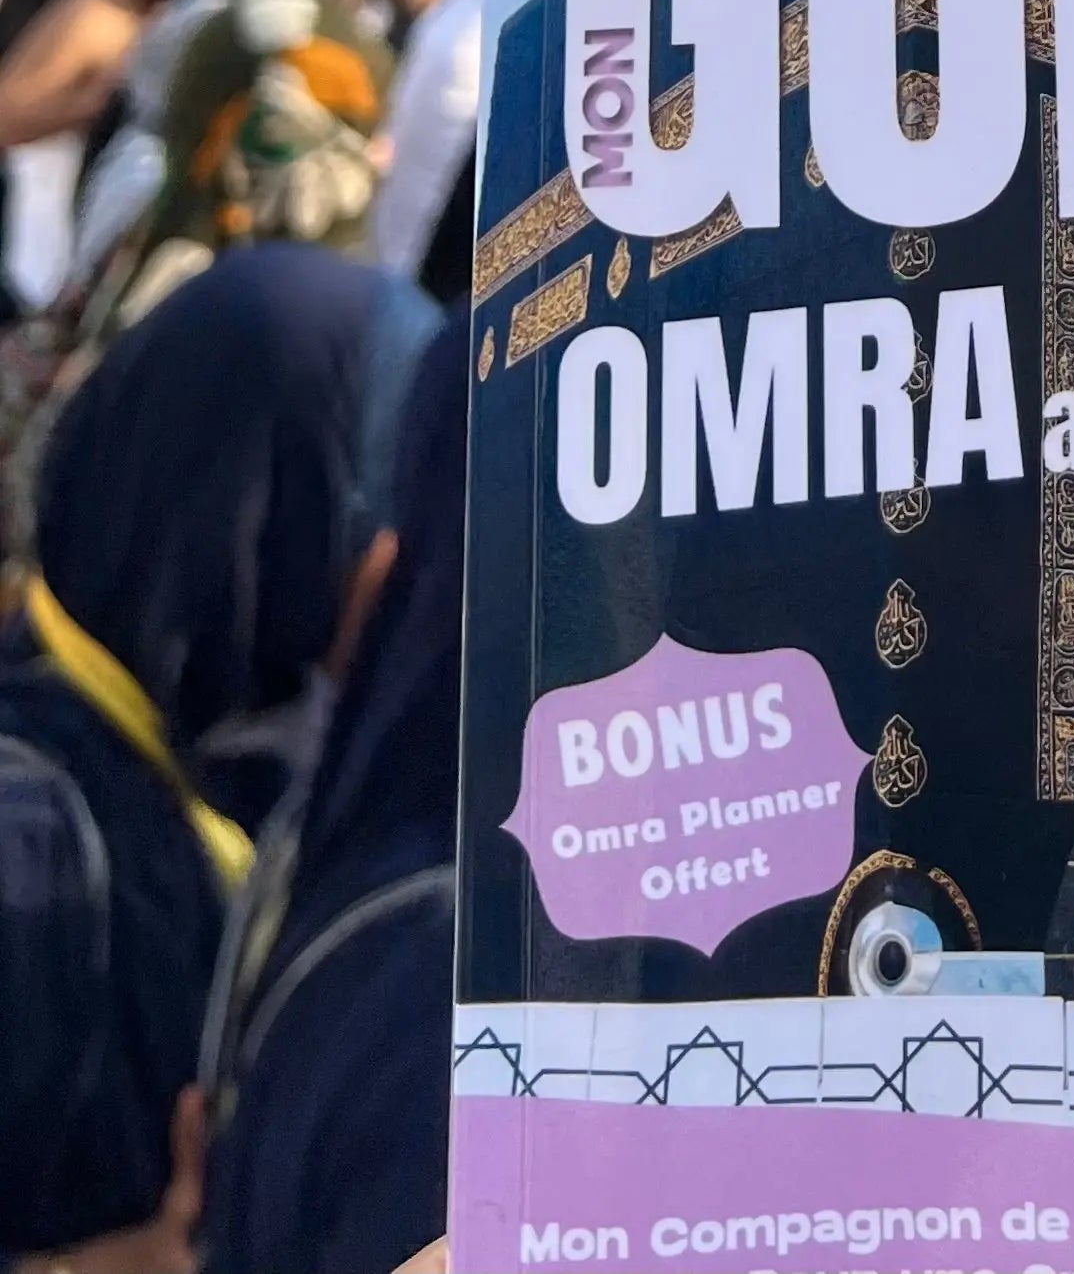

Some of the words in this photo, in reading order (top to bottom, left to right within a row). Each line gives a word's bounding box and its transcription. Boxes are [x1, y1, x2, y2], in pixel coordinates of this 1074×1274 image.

[581, 26, 636, 189] MON
[557, 285, 1024, 525] OMRA
[557, 683, 792, 788] BONUS
[551, 819, 667, 859] Omra
[680, 781, 842, 837] Planner
[640, 847, 770, 900] Offert
[520, 1222, 629, 1264] Mon
[650, 1207, 982, 1257] Compagnon
[1001, 1201, 1070, 1242] de
